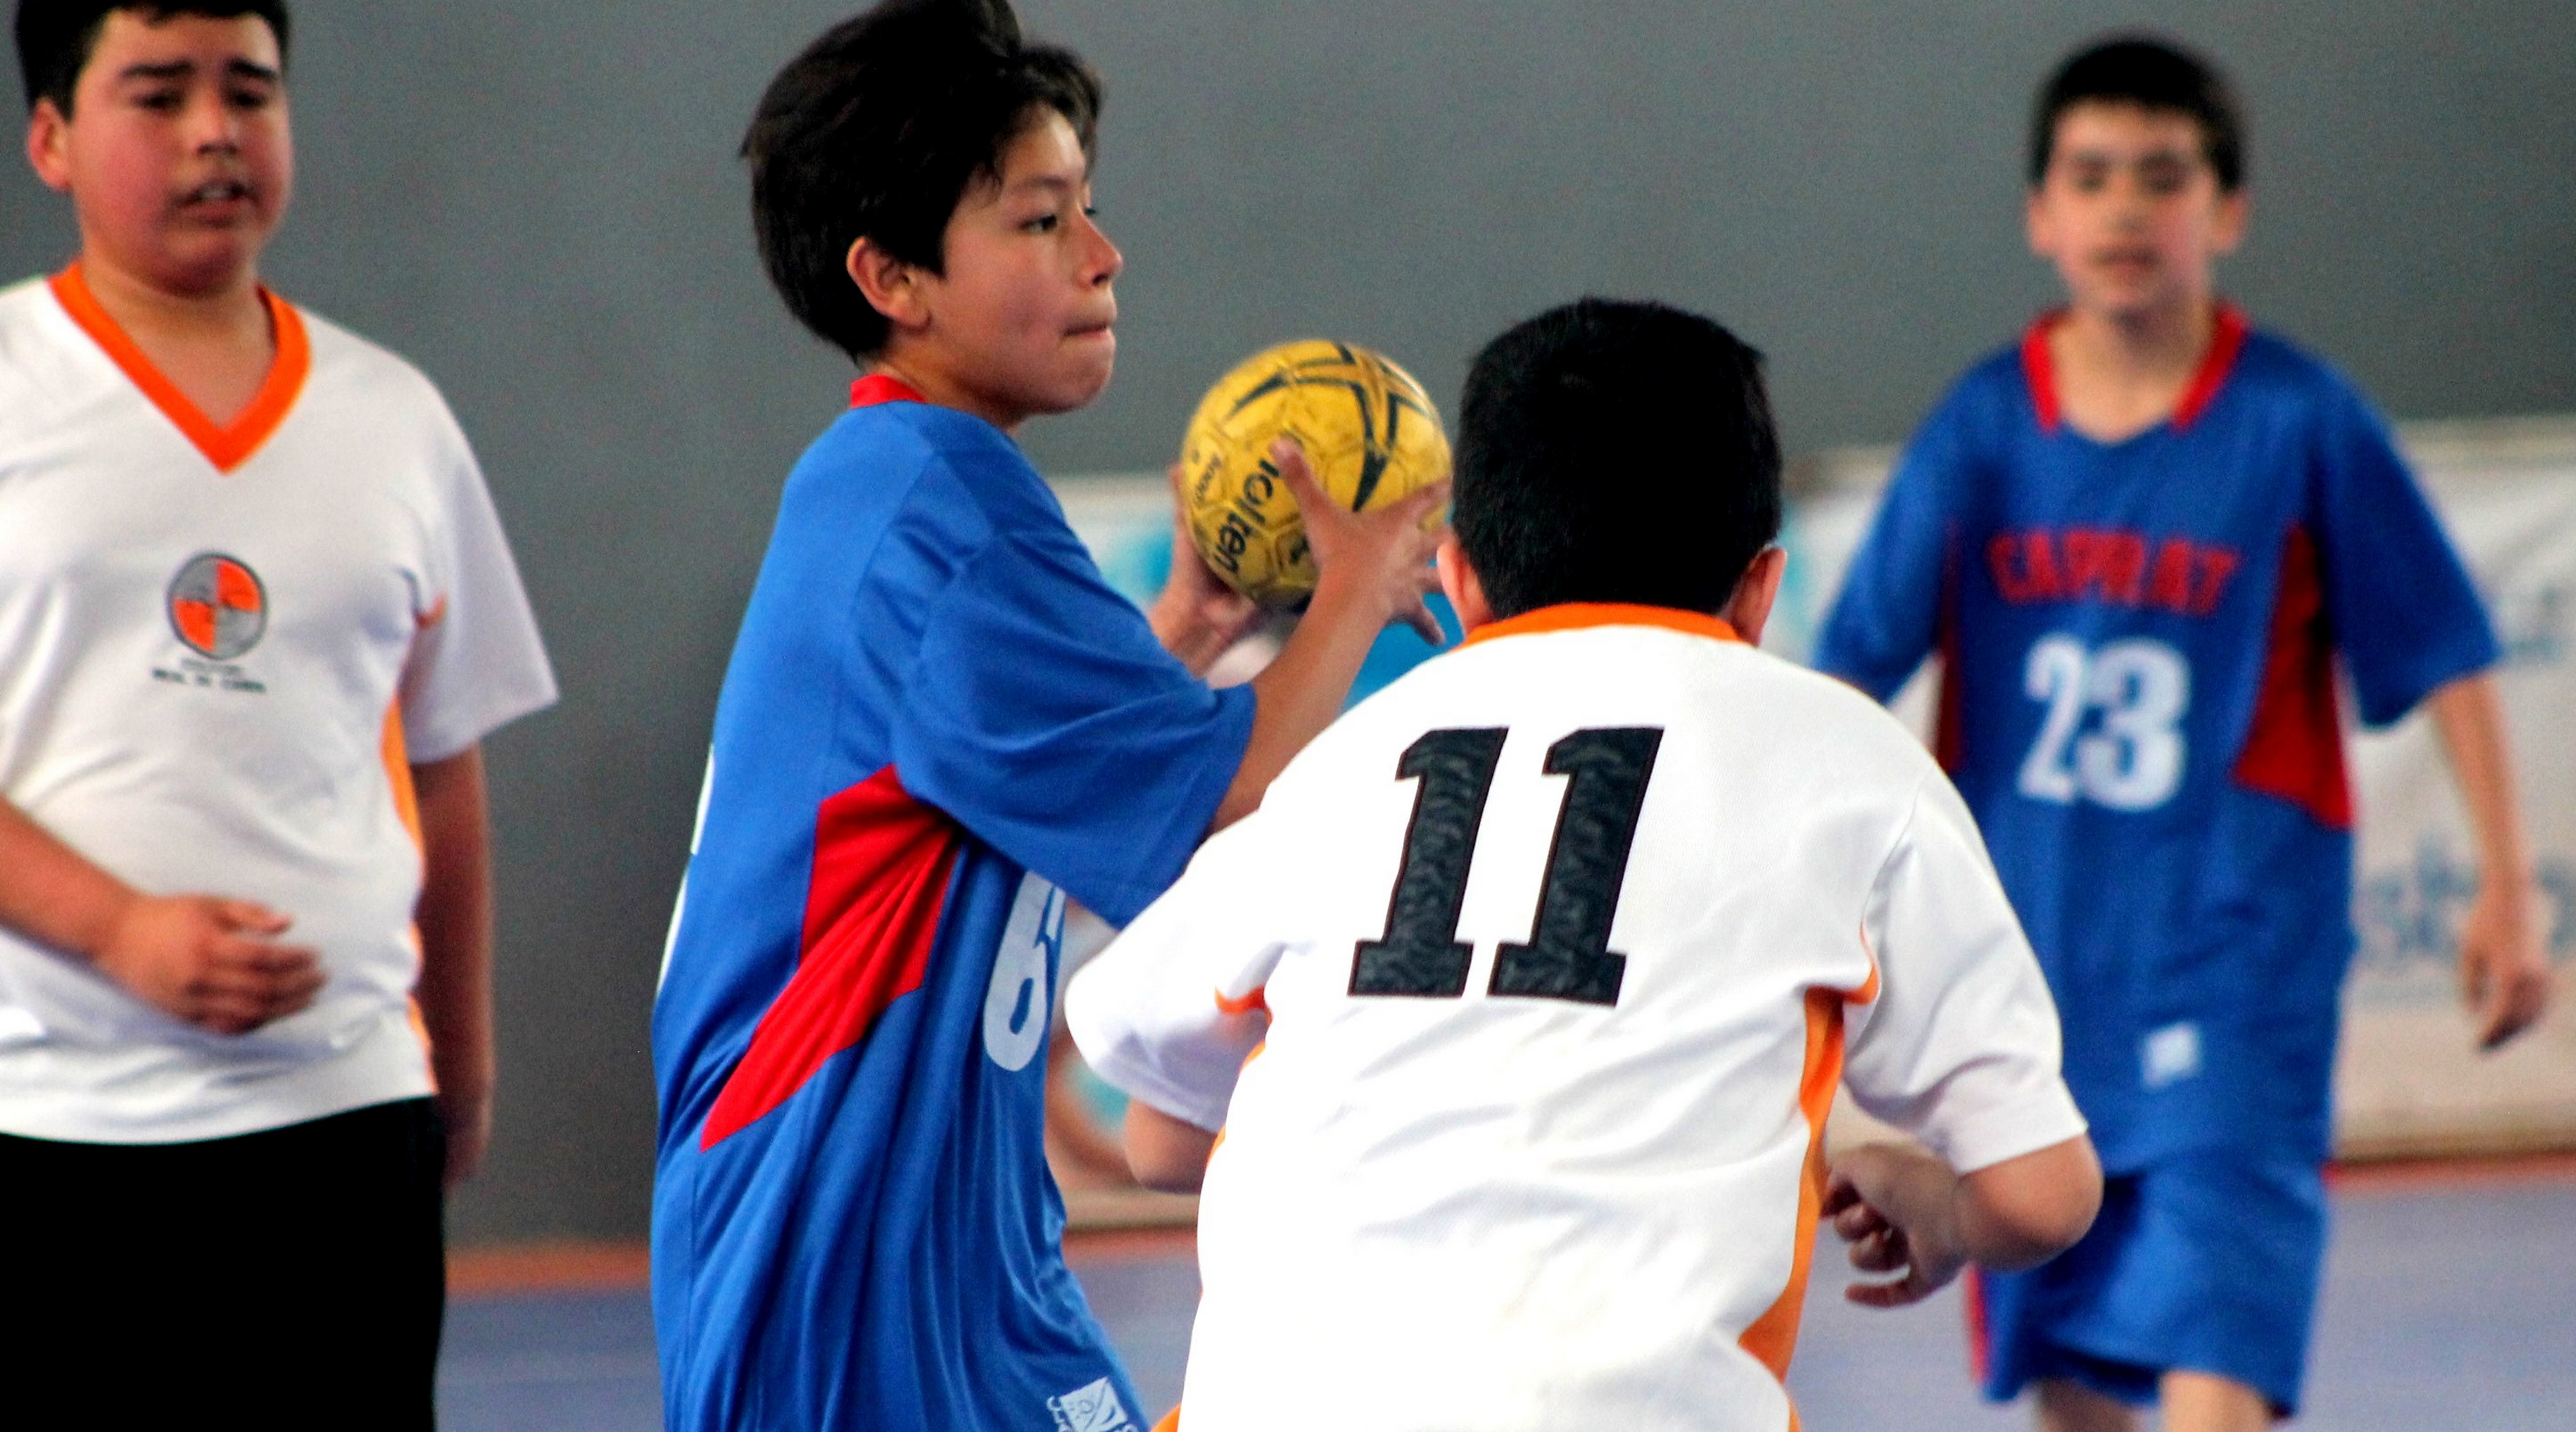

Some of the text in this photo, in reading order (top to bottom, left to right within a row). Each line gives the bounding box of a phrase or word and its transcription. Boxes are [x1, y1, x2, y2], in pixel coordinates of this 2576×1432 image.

[2019, 634, 2190, 811] 23
[1347, 726, 1665, 1007] 11
[983, 870, 1066, 1072] 6
